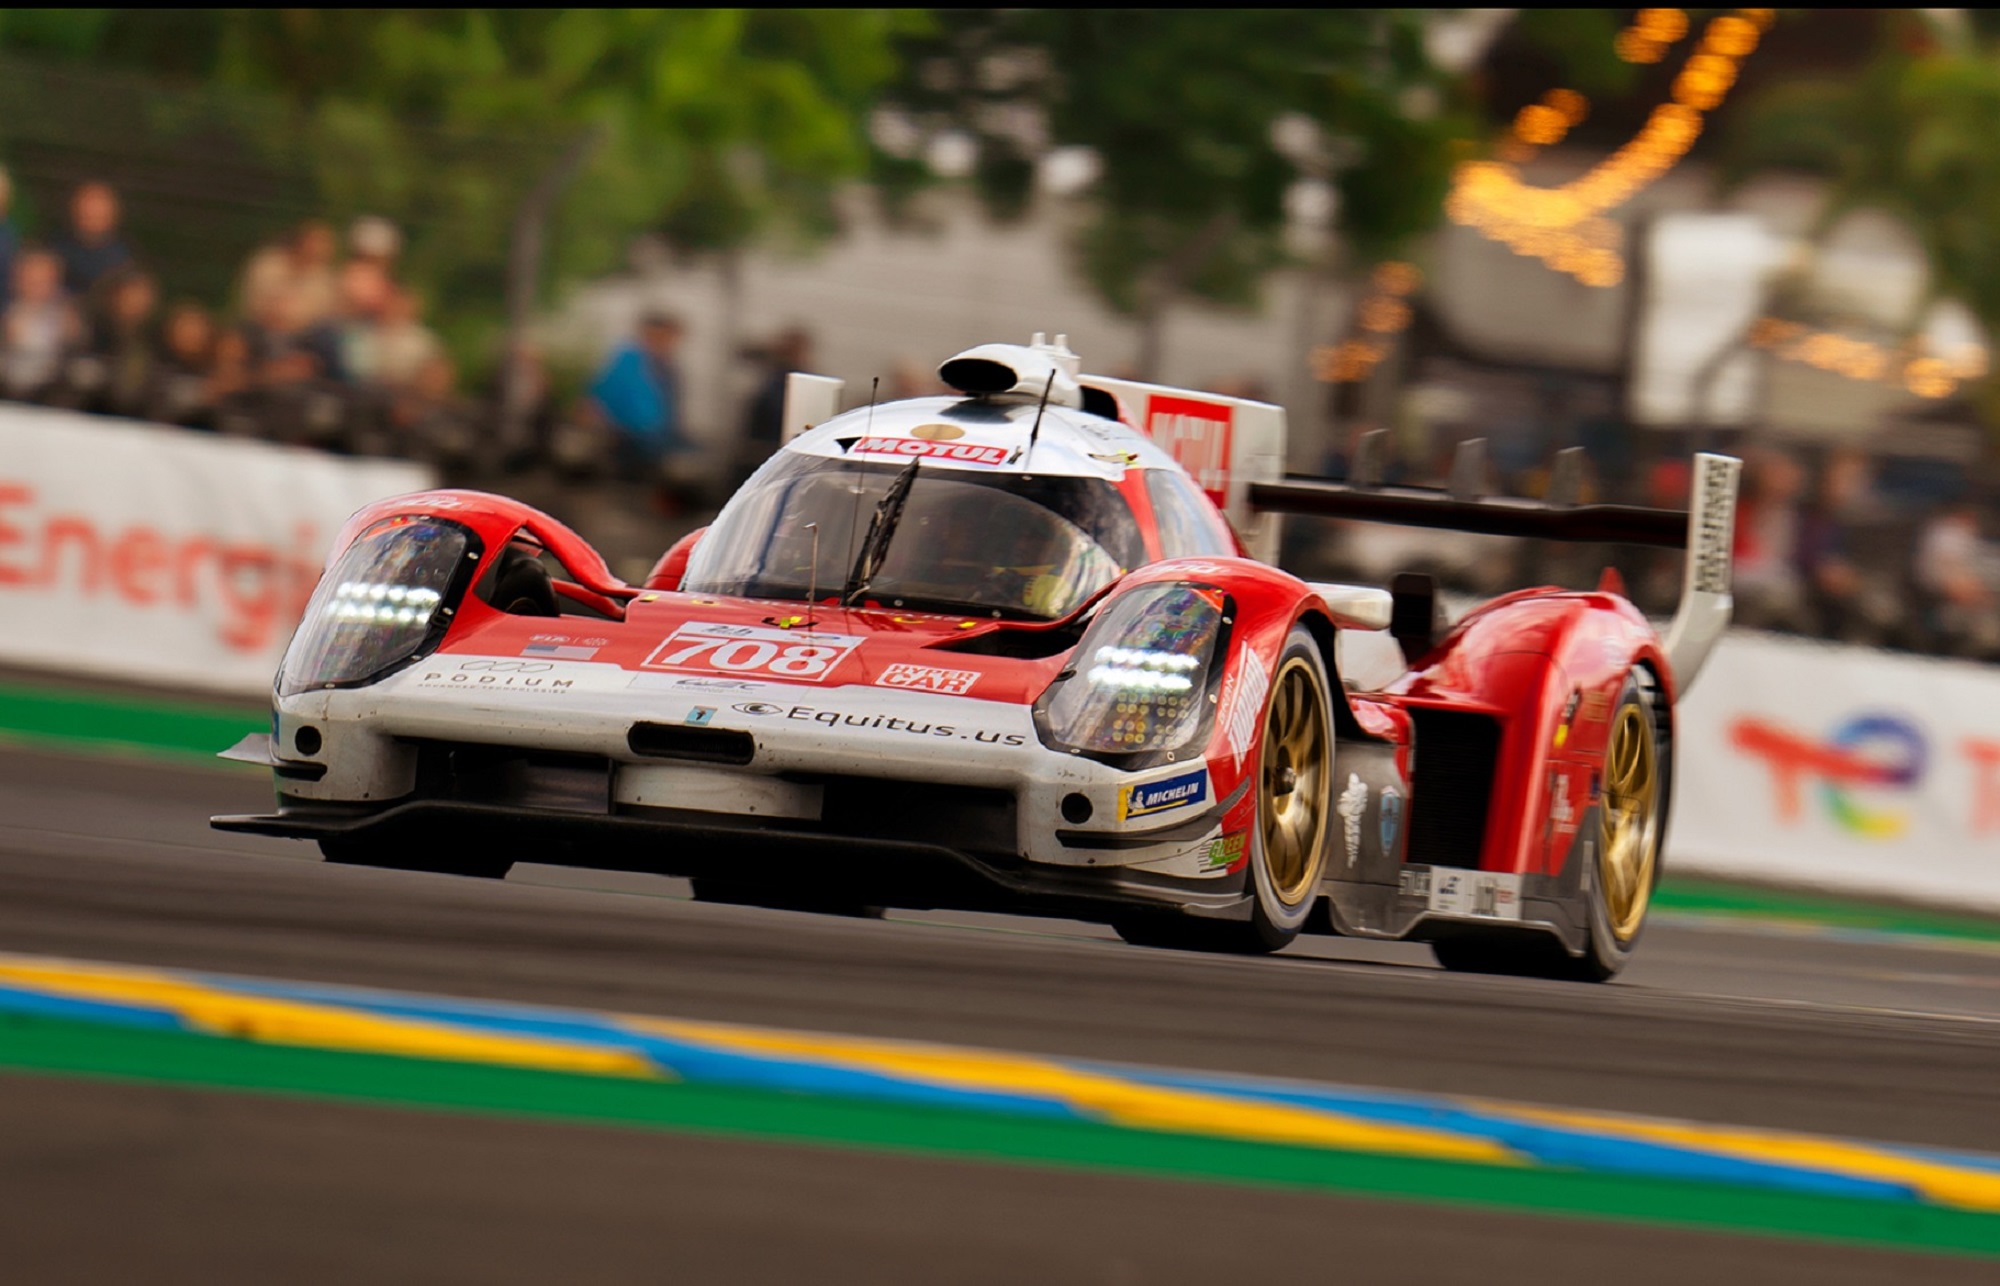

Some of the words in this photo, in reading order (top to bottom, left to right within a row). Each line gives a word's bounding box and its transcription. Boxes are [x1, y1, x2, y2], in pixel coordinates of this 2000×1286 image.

[865, 437, 1004, 463] MOTUL
[661, 635, 837, 675] 708
[424, 673, 574, 688] PODIUM
[883, 672, 963, 692] CAR
[890, 664, 974, 681] HYPER
[787, 705, 1026, 747] Equitus.us
[1145, 781, 1200, 806] MICHELIN
